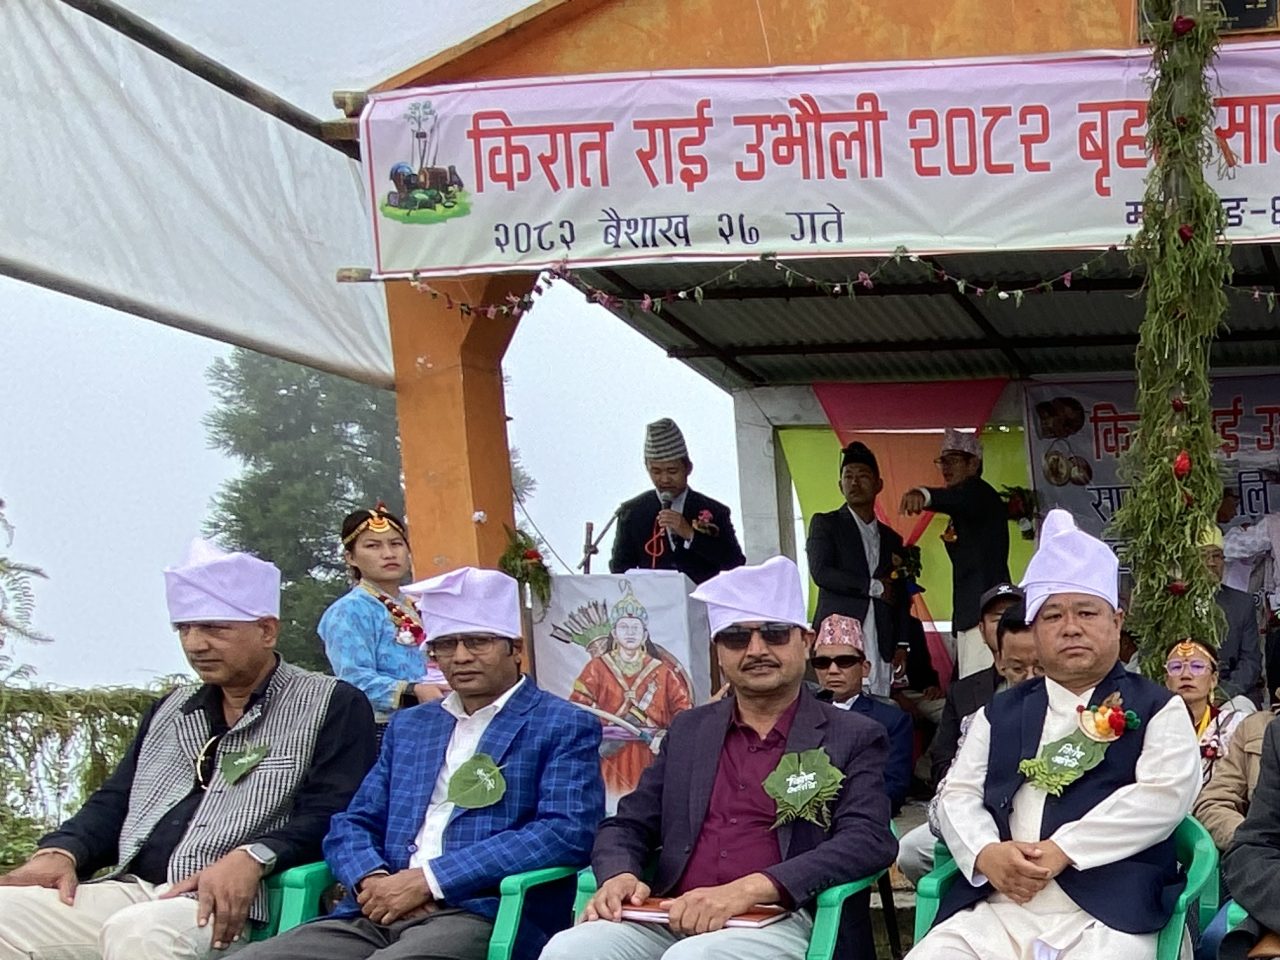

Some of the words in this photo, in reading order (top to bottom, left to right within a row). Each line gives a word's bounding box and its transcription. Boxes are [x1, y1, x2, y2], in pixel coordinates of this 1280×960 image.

[466, 109, 615, 193] किरात
[632, 98, 714, 192] राई
[732, 92, 889, 181] उभौली
[908, 104, 1051, 177] २०८२
[1077, 100, 1152, 197] बृह
[493, 220, 576, 254] २०८२
[598, 207, 691, 249] बैशाख
[717, 213, 761, 245] २७
[785, 203, 846, 245] गते
